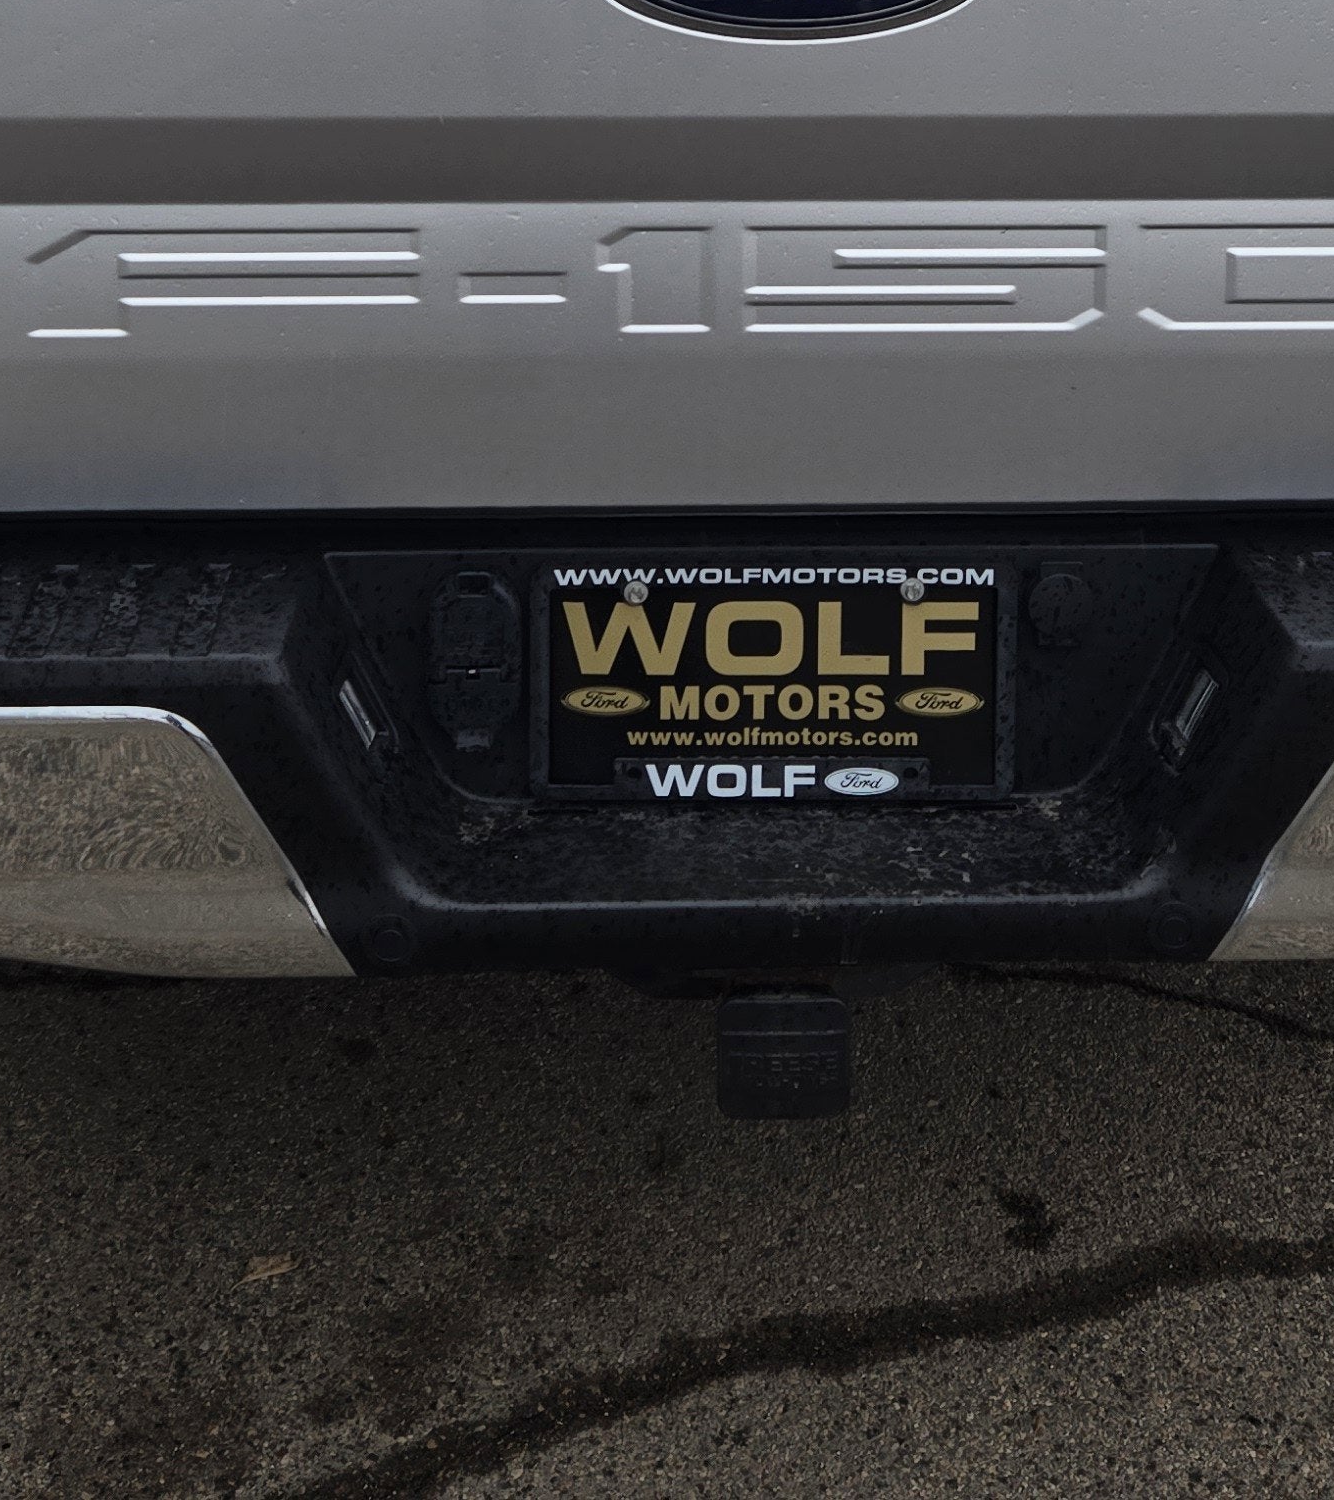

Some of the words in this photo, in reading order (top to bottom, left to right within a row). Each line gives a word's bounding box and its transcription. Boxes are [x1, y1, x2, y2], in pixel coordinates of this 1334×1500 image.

[553, 567, 995, 586] WWW.WOLFMOTORSCOM
[562, 600, 980, 676] WOLF
[580, 690, 629, 710] Ford
[659, 684, 886, 721] MOTORS
[914, 691, 964, 711] Ford
[626, 726, 919, 746] www.wolfmotors.com
[645, 764, 817, 798] WOLF
[840, 771, 884, 790] Ford
